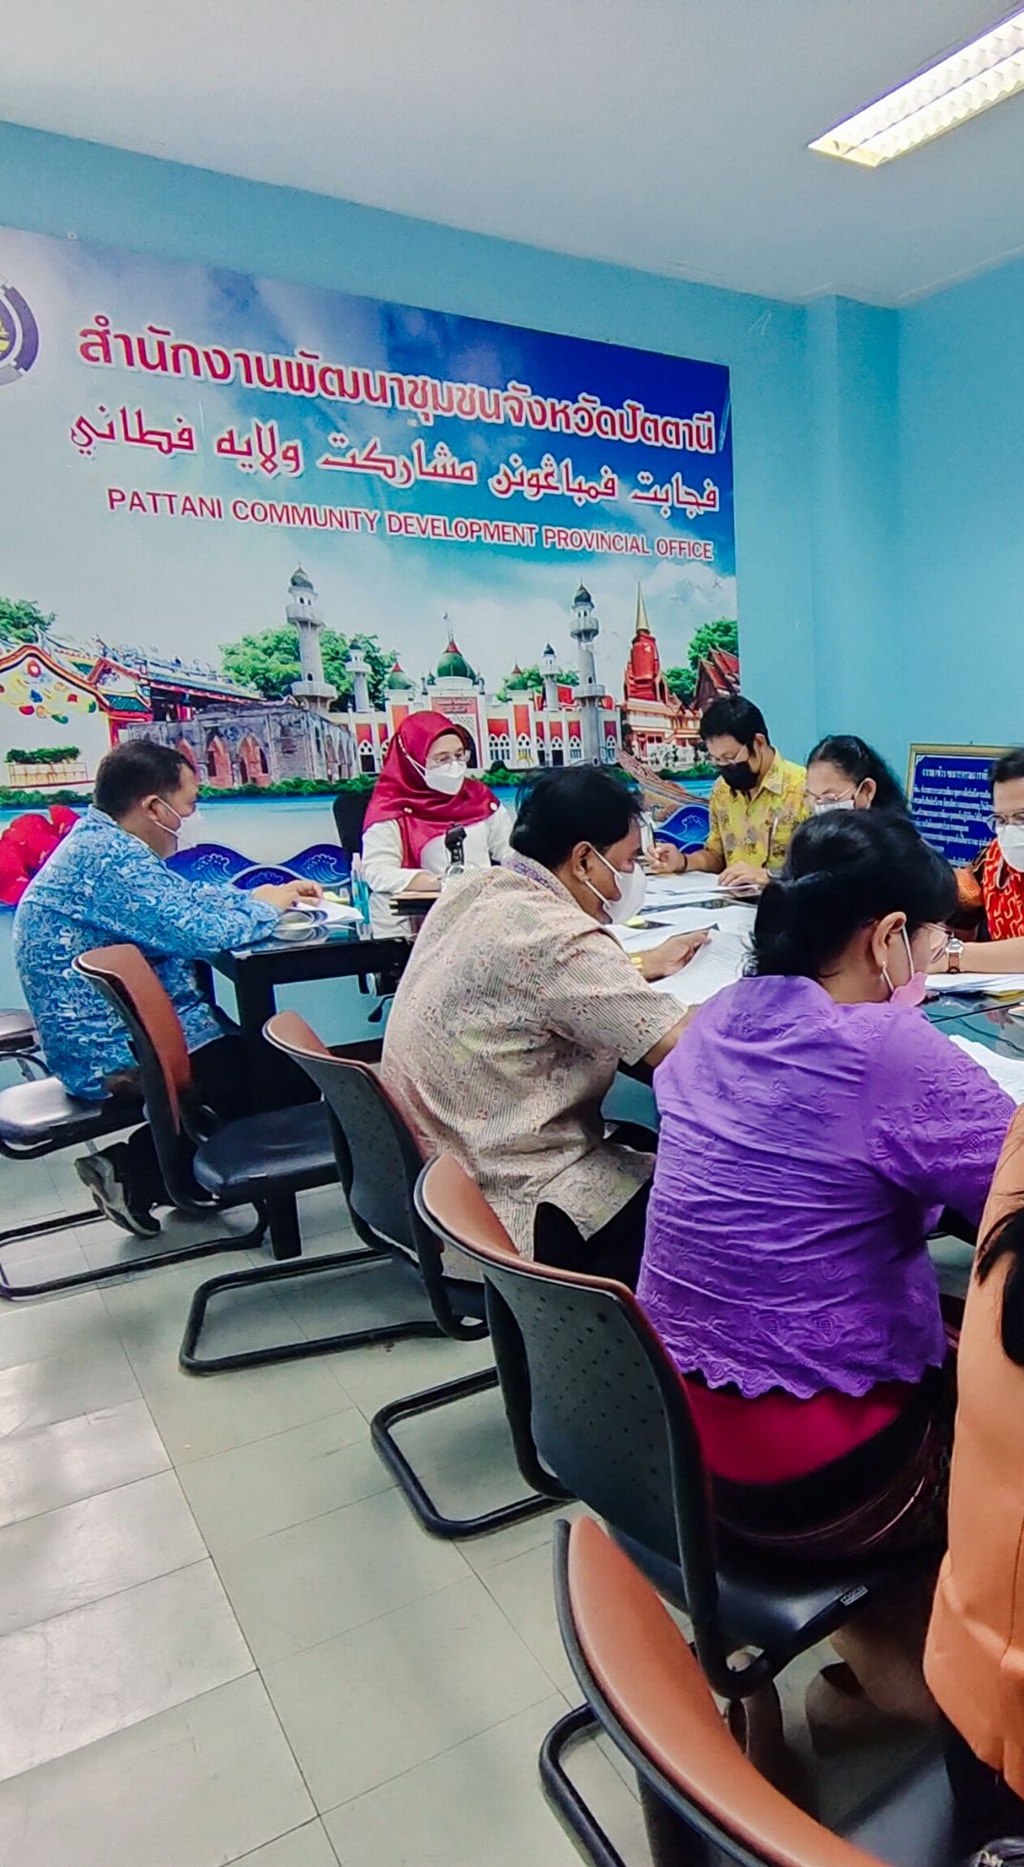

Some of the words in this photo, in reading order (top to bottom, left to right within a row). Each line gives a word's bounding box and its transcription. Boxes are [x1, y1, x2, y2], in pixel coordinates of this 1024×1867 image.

[79, 315, 714, 450] สำนักงานพัฒนาชุมชนจังหวัดปัตตานี
[107, 488, 223, 519] PATTANI
[231, 499, 379, 532] COMMUNITY
[387, 513, 538, 547] DEVELOPMENT
[543, 528, 651, 554] PROVINCIAL
[656, 538, 714, 560] OFFICE
